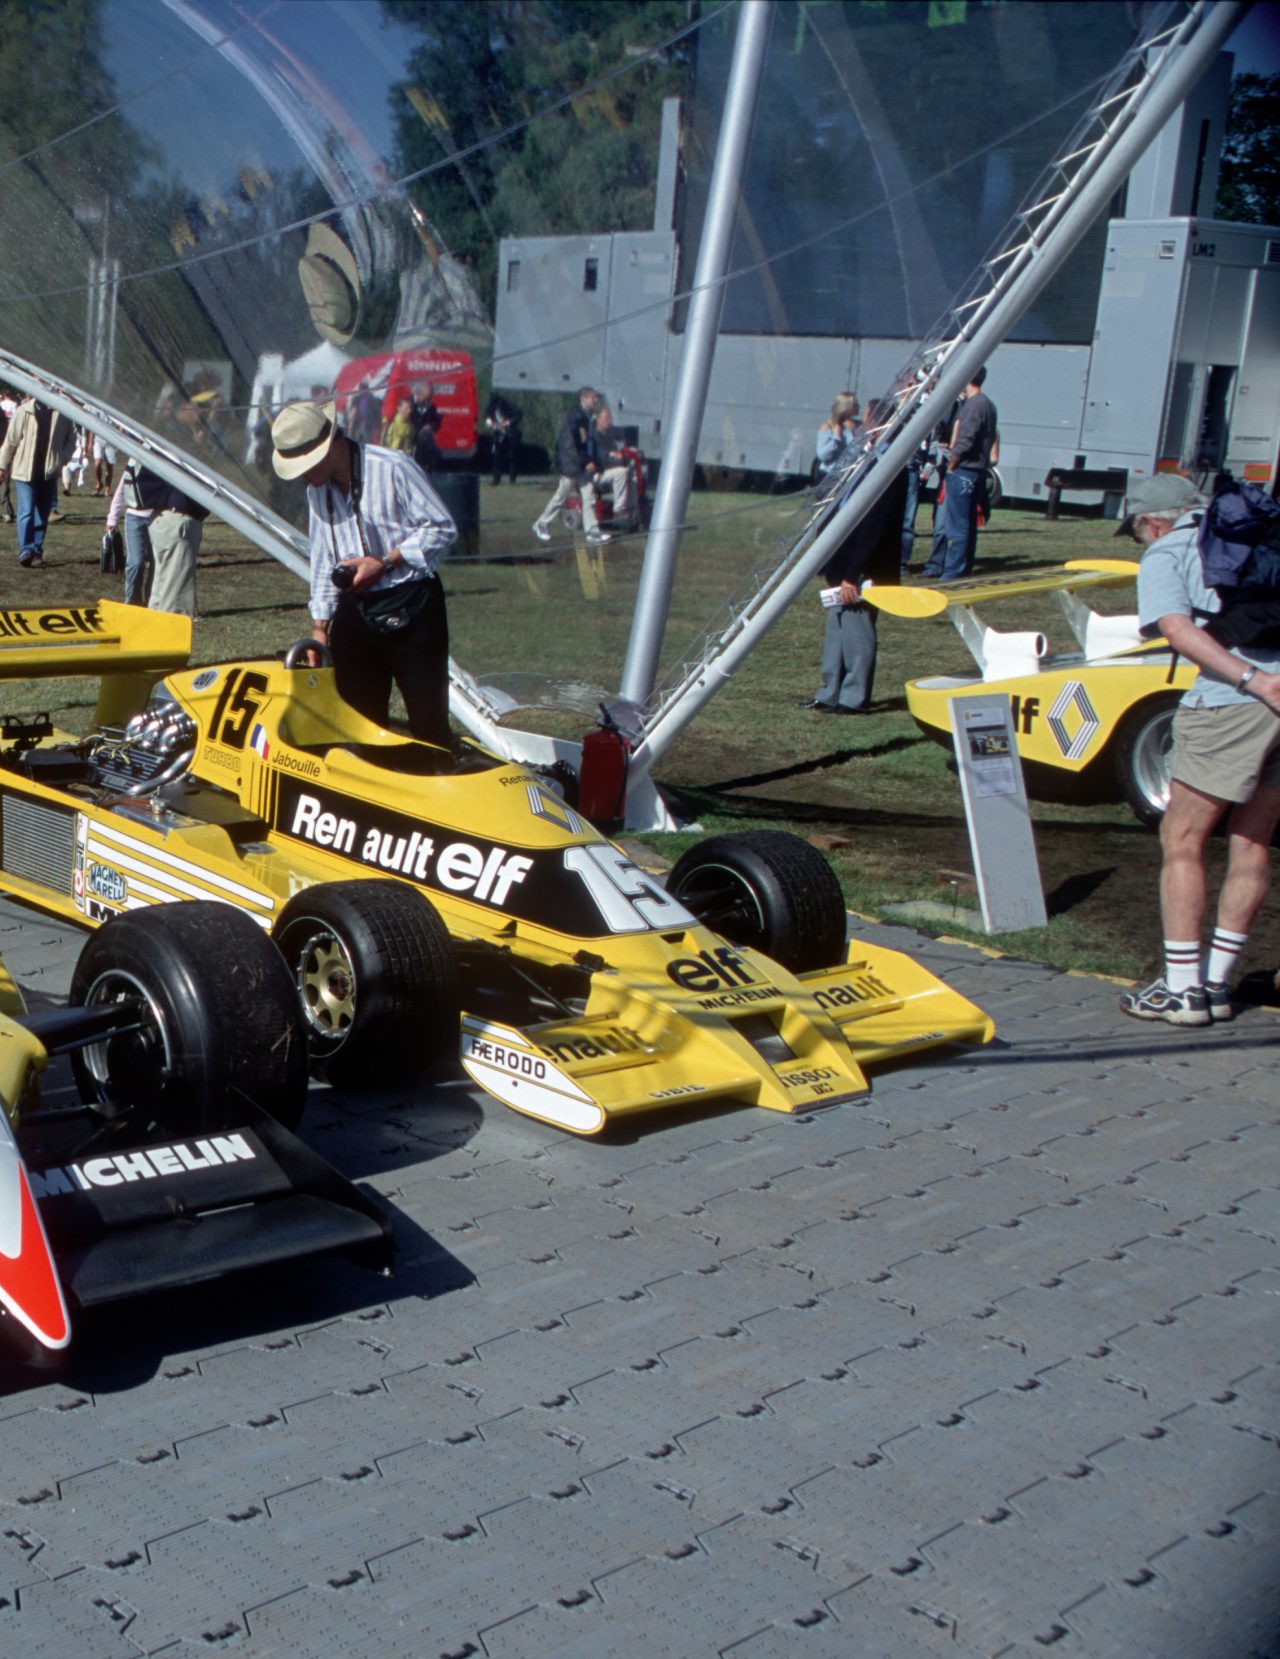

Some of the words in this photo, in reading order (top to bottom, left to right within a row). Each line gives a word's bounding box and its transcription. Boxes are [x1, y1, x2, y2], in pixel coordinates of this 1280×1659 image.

[1192, 242, 1216, 257] LM2
[38, 608, 104, 634] elf
[207, 668, 270, 751] 15
[1011, 694, 1041, 735] lf
[272, 750, 321, 778] Jabouille
[436, 843, 534, 907] elf
[563, 844, 701, 933] 15
[666, 947, 755, 992] elf
[697, 986, 785, 1010] MICHELIN
[812, 974, 896, 1010] nault
[28, 1133, 256, 1199] MICHELIN
